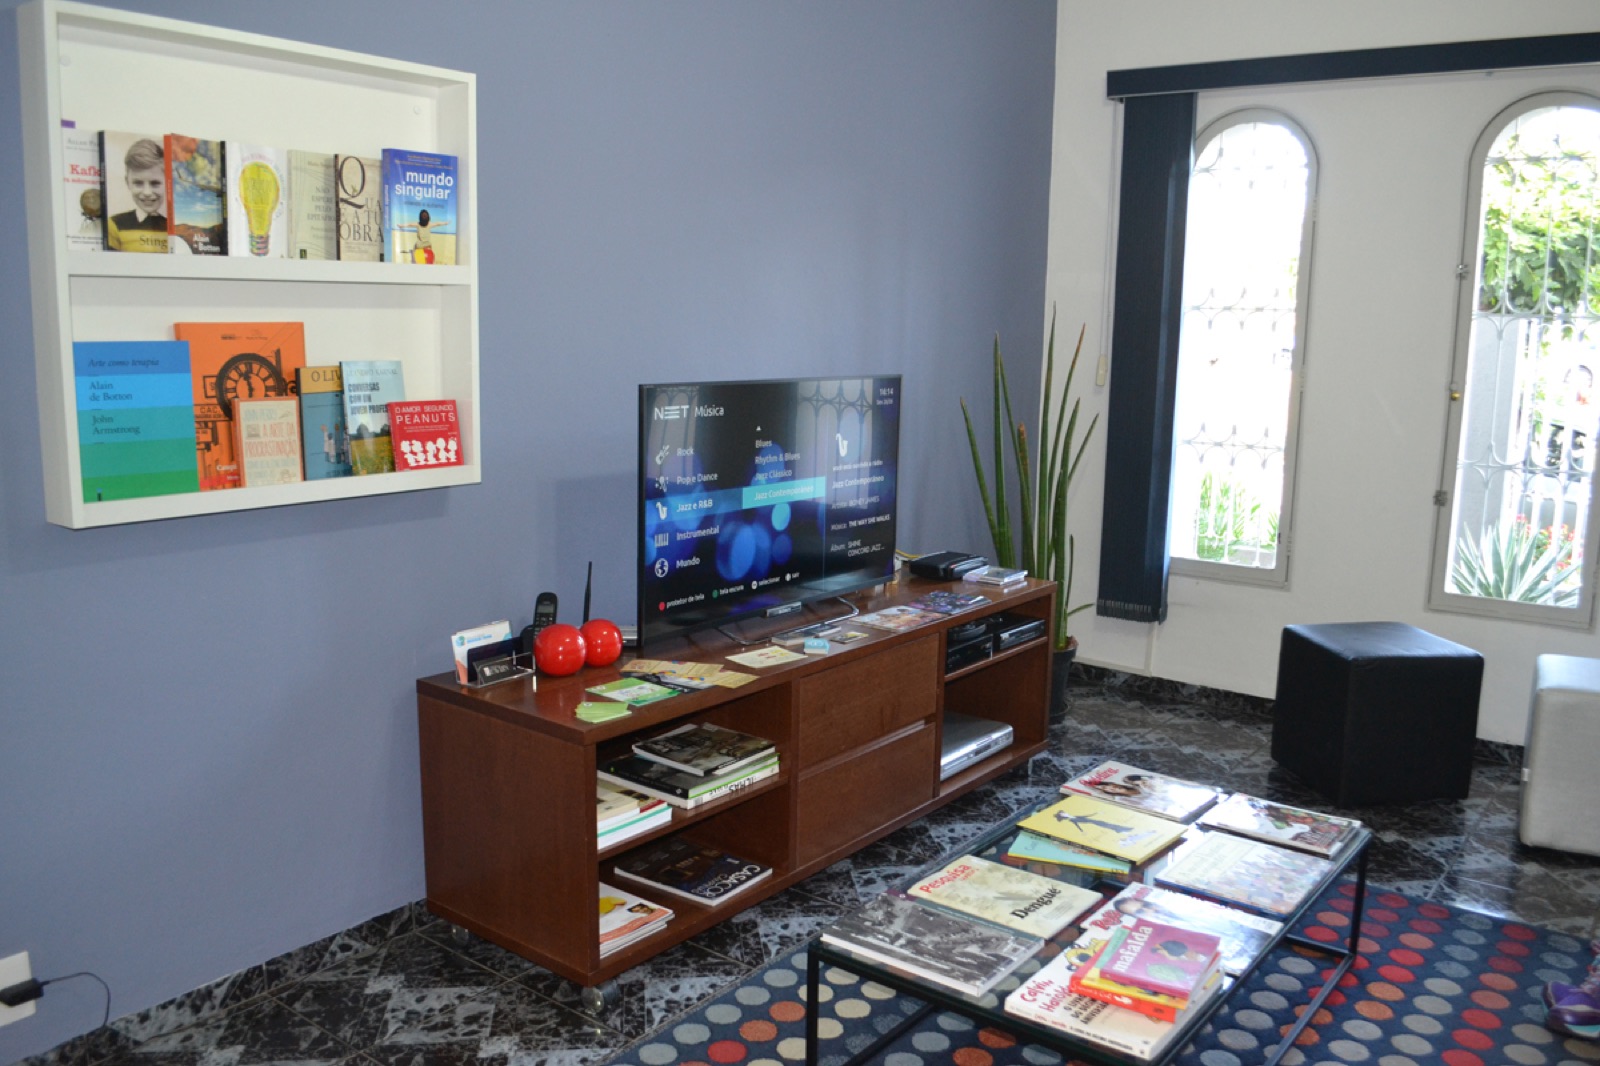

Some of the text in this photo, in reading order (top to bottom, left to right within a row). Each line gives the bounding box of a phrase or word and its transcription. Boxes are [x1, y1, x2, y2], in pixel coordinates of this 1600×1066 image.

[70, 163, 102, 177] Kafk
[405, 171, 454, 187] mundo
[395, 182, 450, 201] singular
[139, 233, 168, 250] Sting
[323, 369, 341, 382] LIV
[396, 412, 456, 425] PEANUTS
[654, 404, 690, 420] NET
[919, 864, 972, 893] Pesquisa
[1112, 926, 1153, 972] mafalda
[1039, 985, 1071, 1013] Harold
